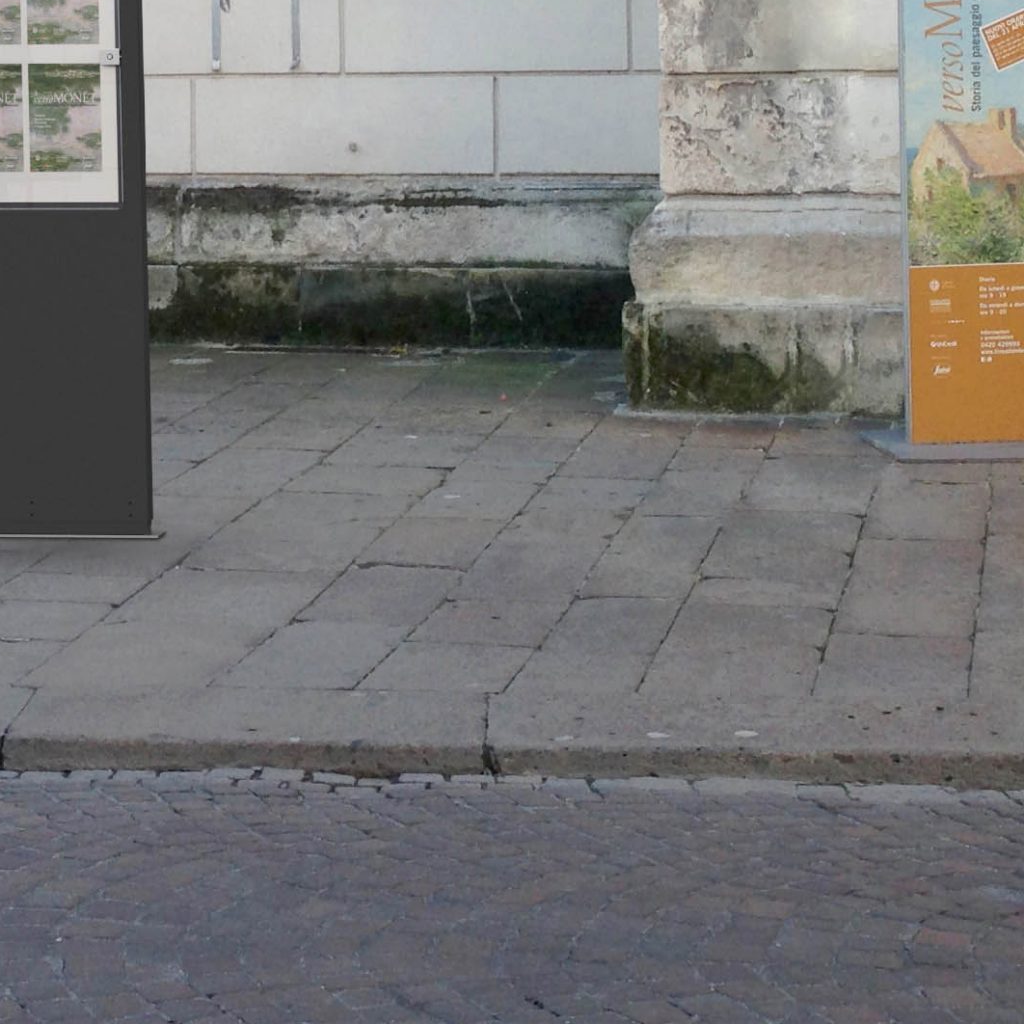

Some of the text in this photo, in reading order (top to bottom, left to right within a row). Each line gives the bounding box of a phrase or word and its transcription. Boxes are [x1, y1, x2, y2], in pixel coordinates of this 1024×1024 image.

[970, 4, 982, 58] paesaggio
[971, 62, 981, 78] del
[971, 81, 982, 112] Storia
